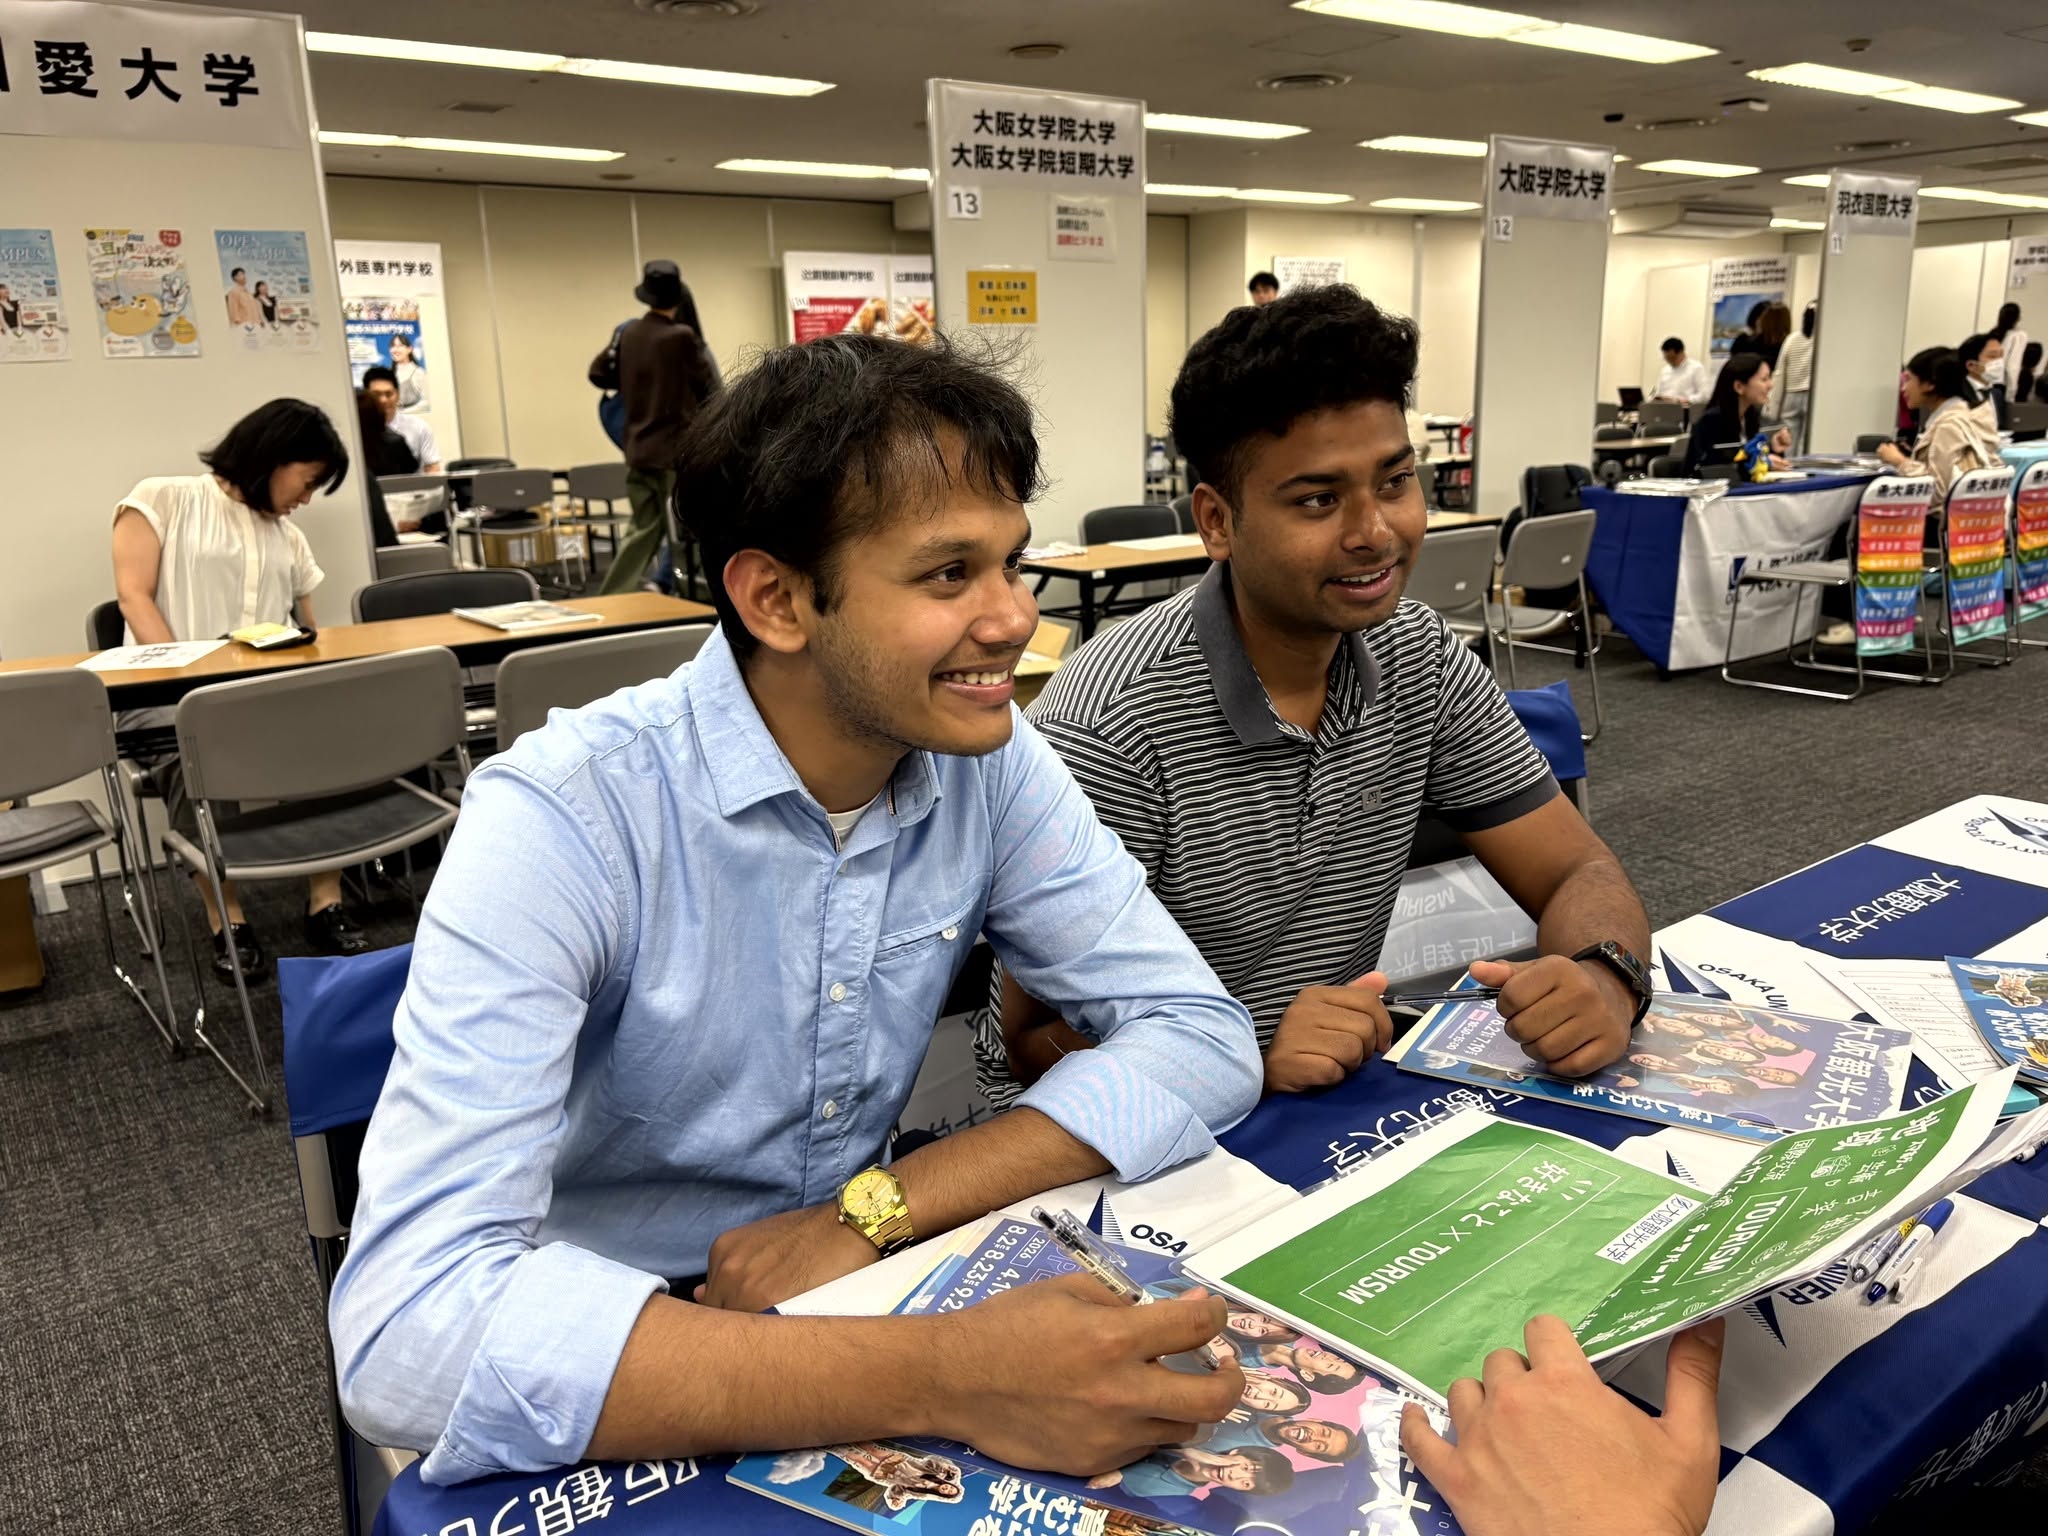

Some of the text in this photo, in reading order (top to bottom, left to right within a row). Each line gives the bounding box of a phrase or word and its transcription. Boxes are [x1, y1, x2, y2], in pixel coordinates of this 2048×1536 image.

[0, 36, 260, 107] 愛大学
[973, 109, 1117, 145] 大阪女学院大学
[951, 142, 1135, 179] 大阪女学院短期大学
[1499, 161, 1607, 201] 大阪学院大学
[952, 191, 979, 214] 13
[1836, 190, 1914, 220] 羽衣国際大学
[1493, 217, 1513, 237] 12
[340, 258, 434, 276] 外語専門学校
[1818, 872, 1961, 946] 大阪観光大学
[1697, 963, 1777, 1001] OSAKA
[1457, 1160, 1572, 1231] 好きなこと
[1019, 1236, 1046, 1260] 2026
[1606, 1203, 1680, 1261] 大阪観光大学
[1694, 1195, 1788, 1276] TOURISM
[966, 1250, 1005, 1281] 8.23
[1642, 1222, 1712, 1284] テーマパーク
[1336, 1239, 1453, 1307] TOURISM
